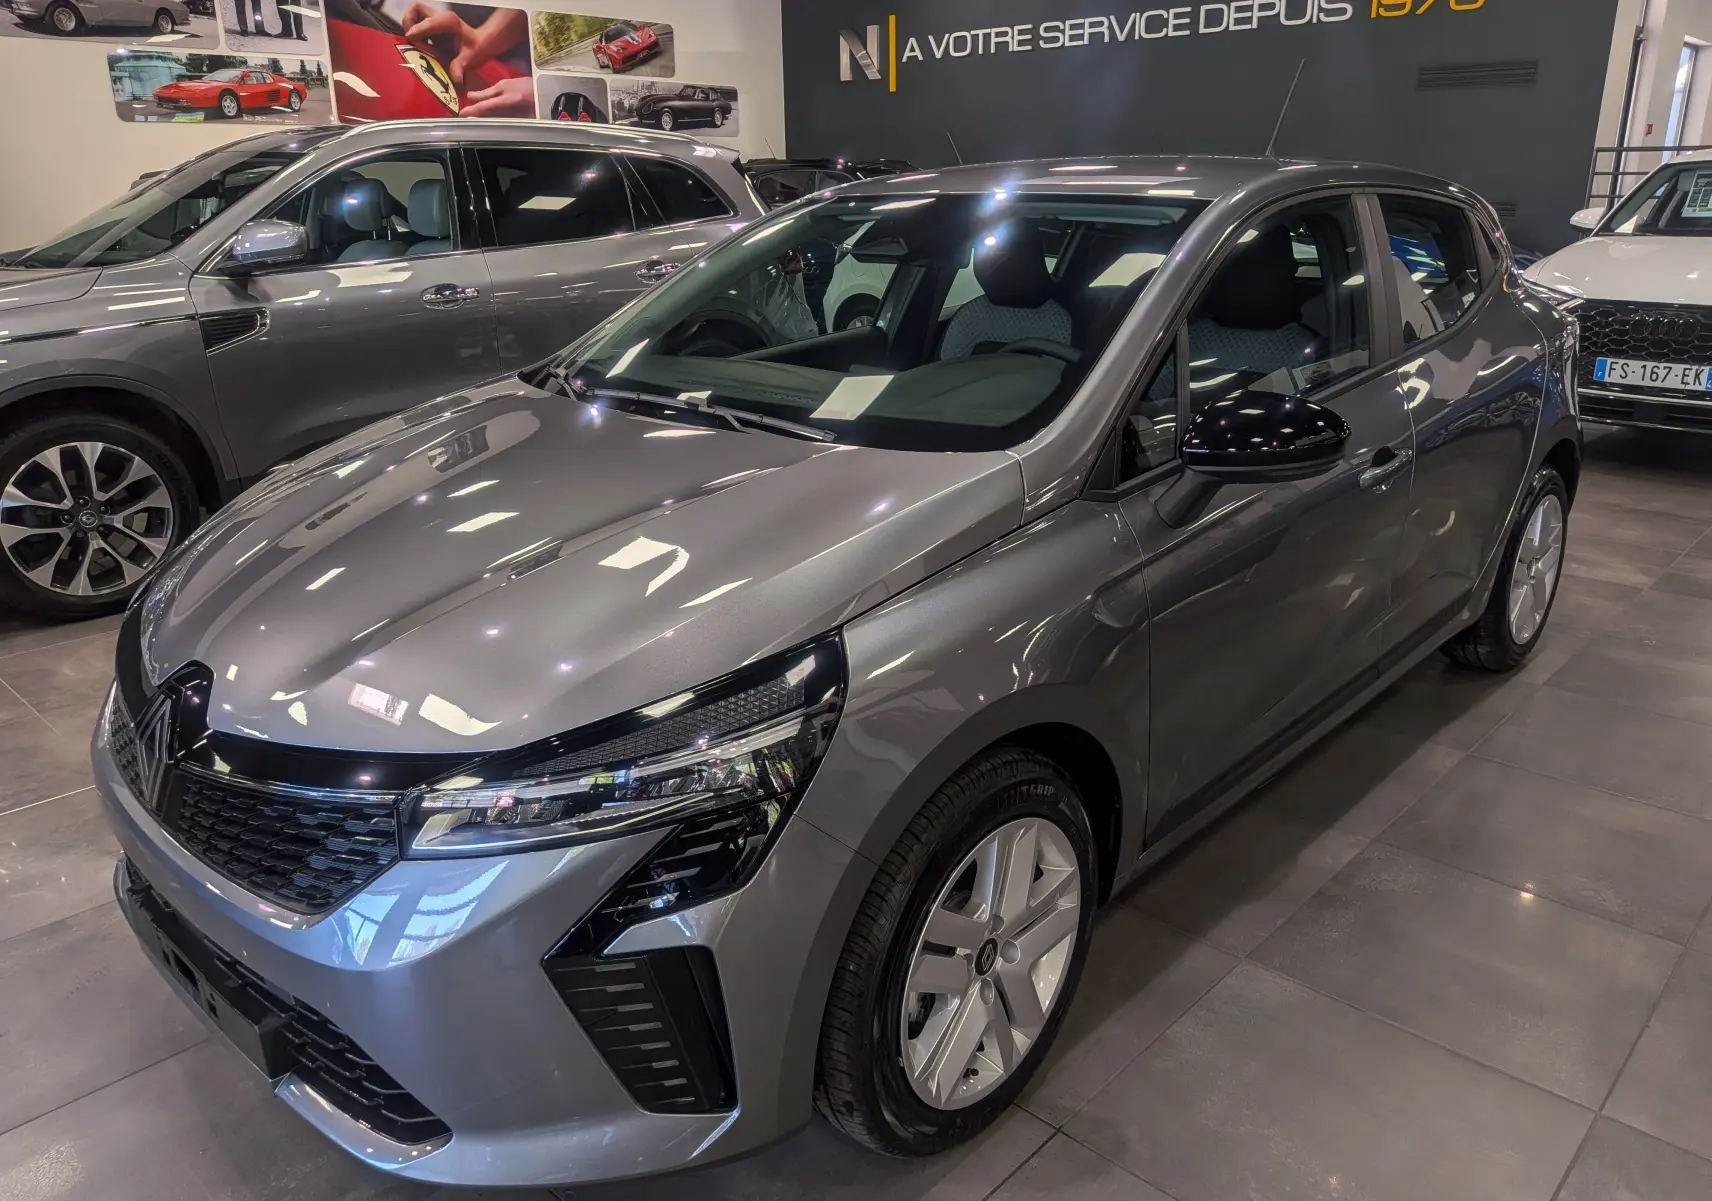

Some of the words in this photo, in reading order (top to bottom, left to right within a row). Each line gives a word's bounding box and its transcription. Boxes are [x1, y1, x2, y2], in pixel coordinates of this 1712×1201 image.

[840, 25, 882, 81] N
[902, 37, 924, 62] A
[928, 24, 1033, 59] VOTRE
[1039, 6, 1192, 49] SERVICE
[1199, 0, 1353, 34] DEPUIS
[1607, 361, 1706, 386] FS-167-EK
